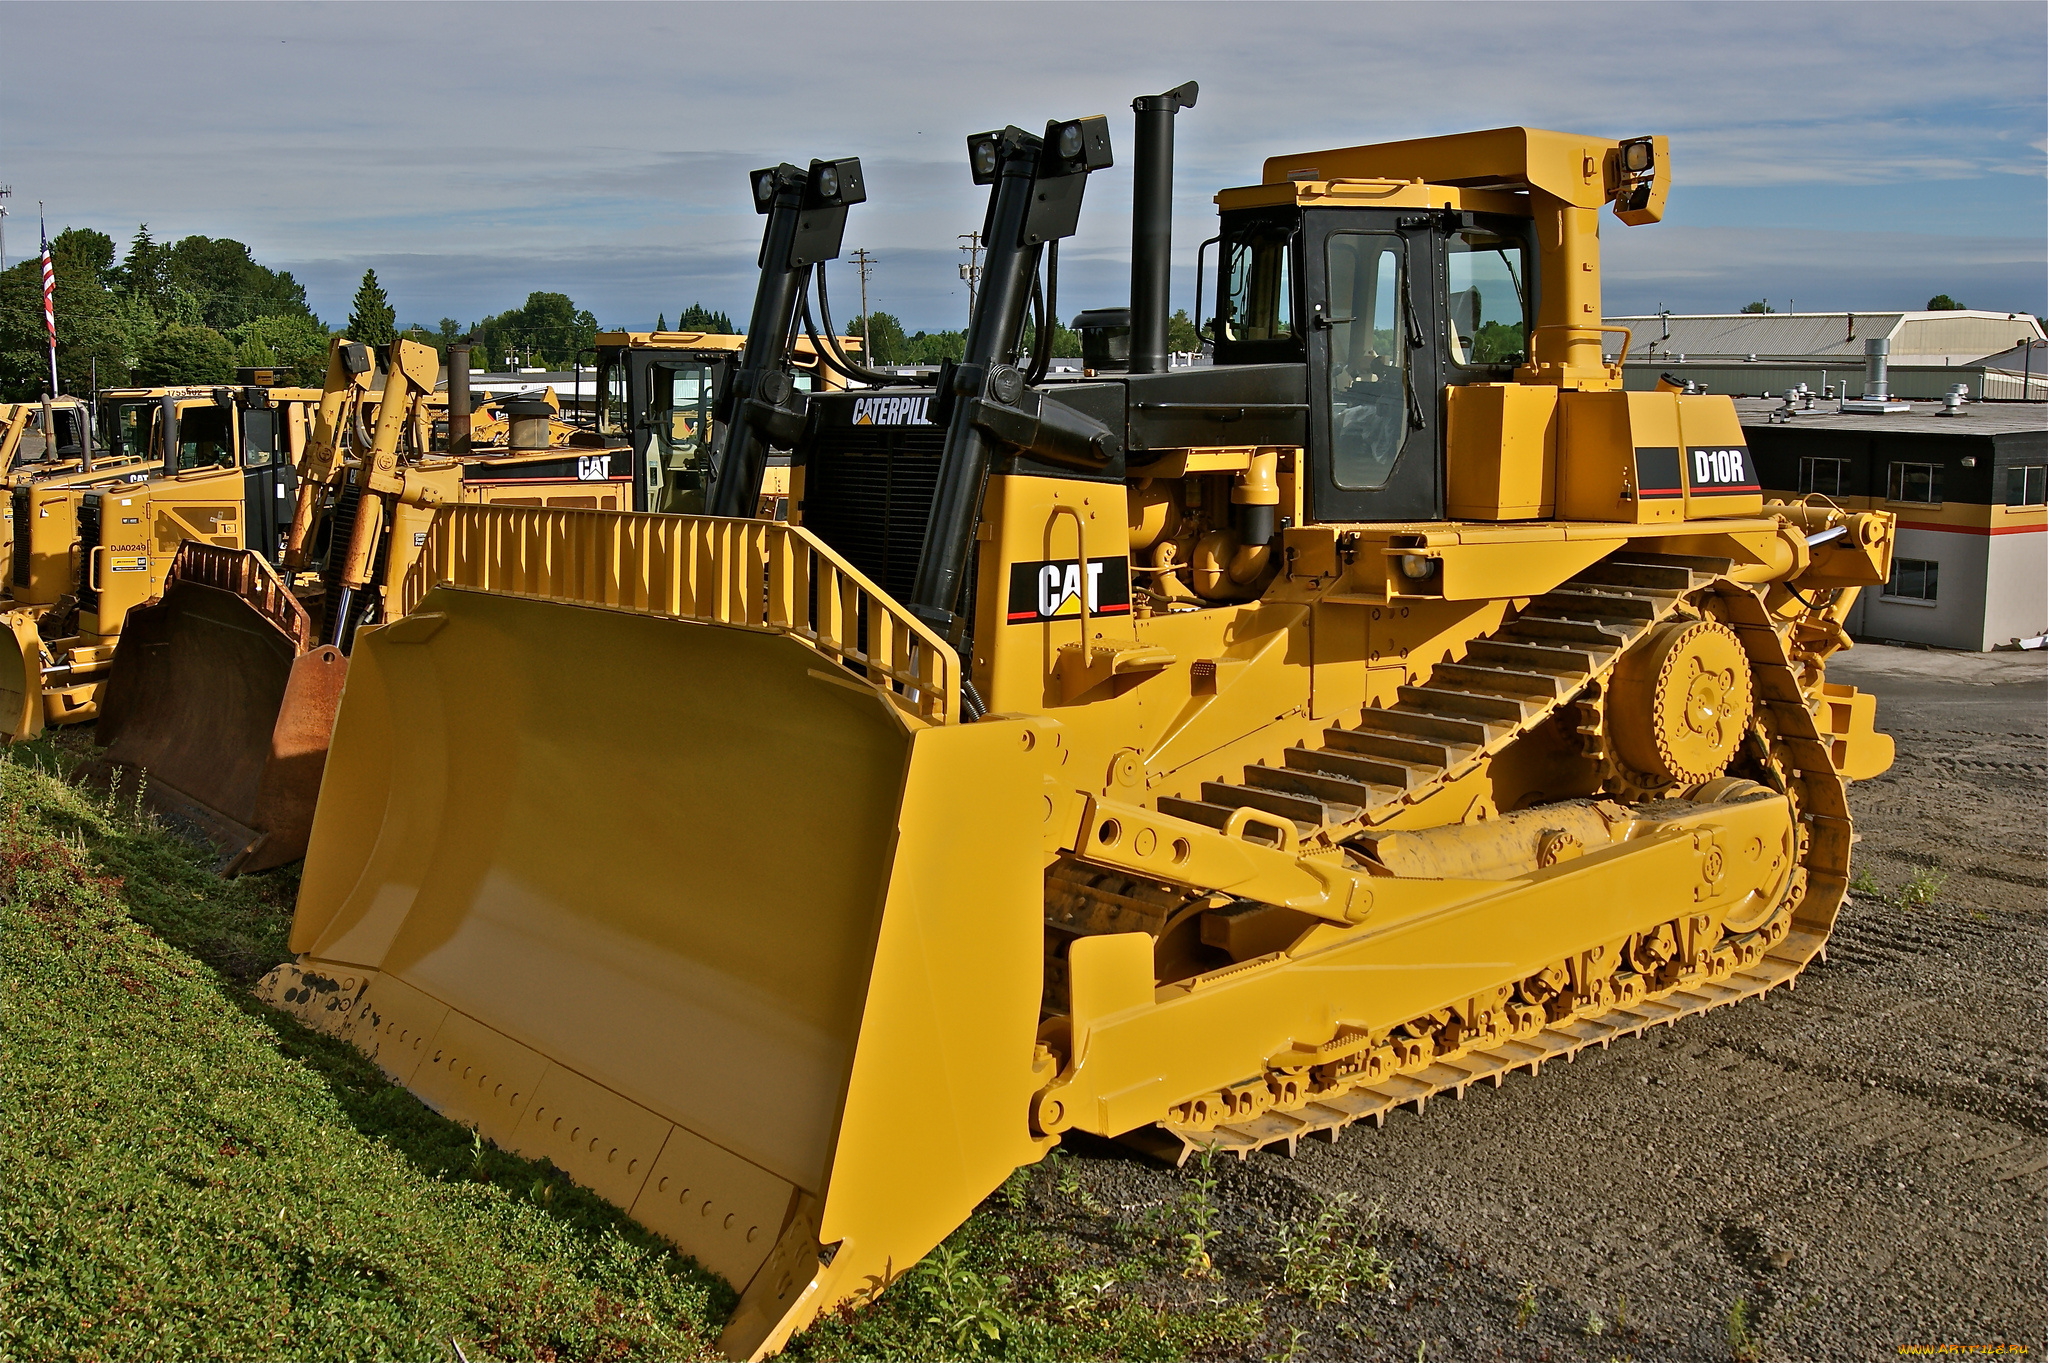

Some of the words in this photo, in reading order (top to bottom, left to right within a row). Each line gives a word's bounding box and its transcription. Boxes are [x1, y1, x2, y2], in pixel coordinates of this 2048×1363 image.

[852, 397, 937, 425] CATERPILL
[129, 474, 149, 483] CAT
[578, 456, 611, 480] CAT
[1694, 450, 1745, 483] D10R
[110, 544, 147, 552] DJA0249
[1038, 562, 1103, 617] CAT
